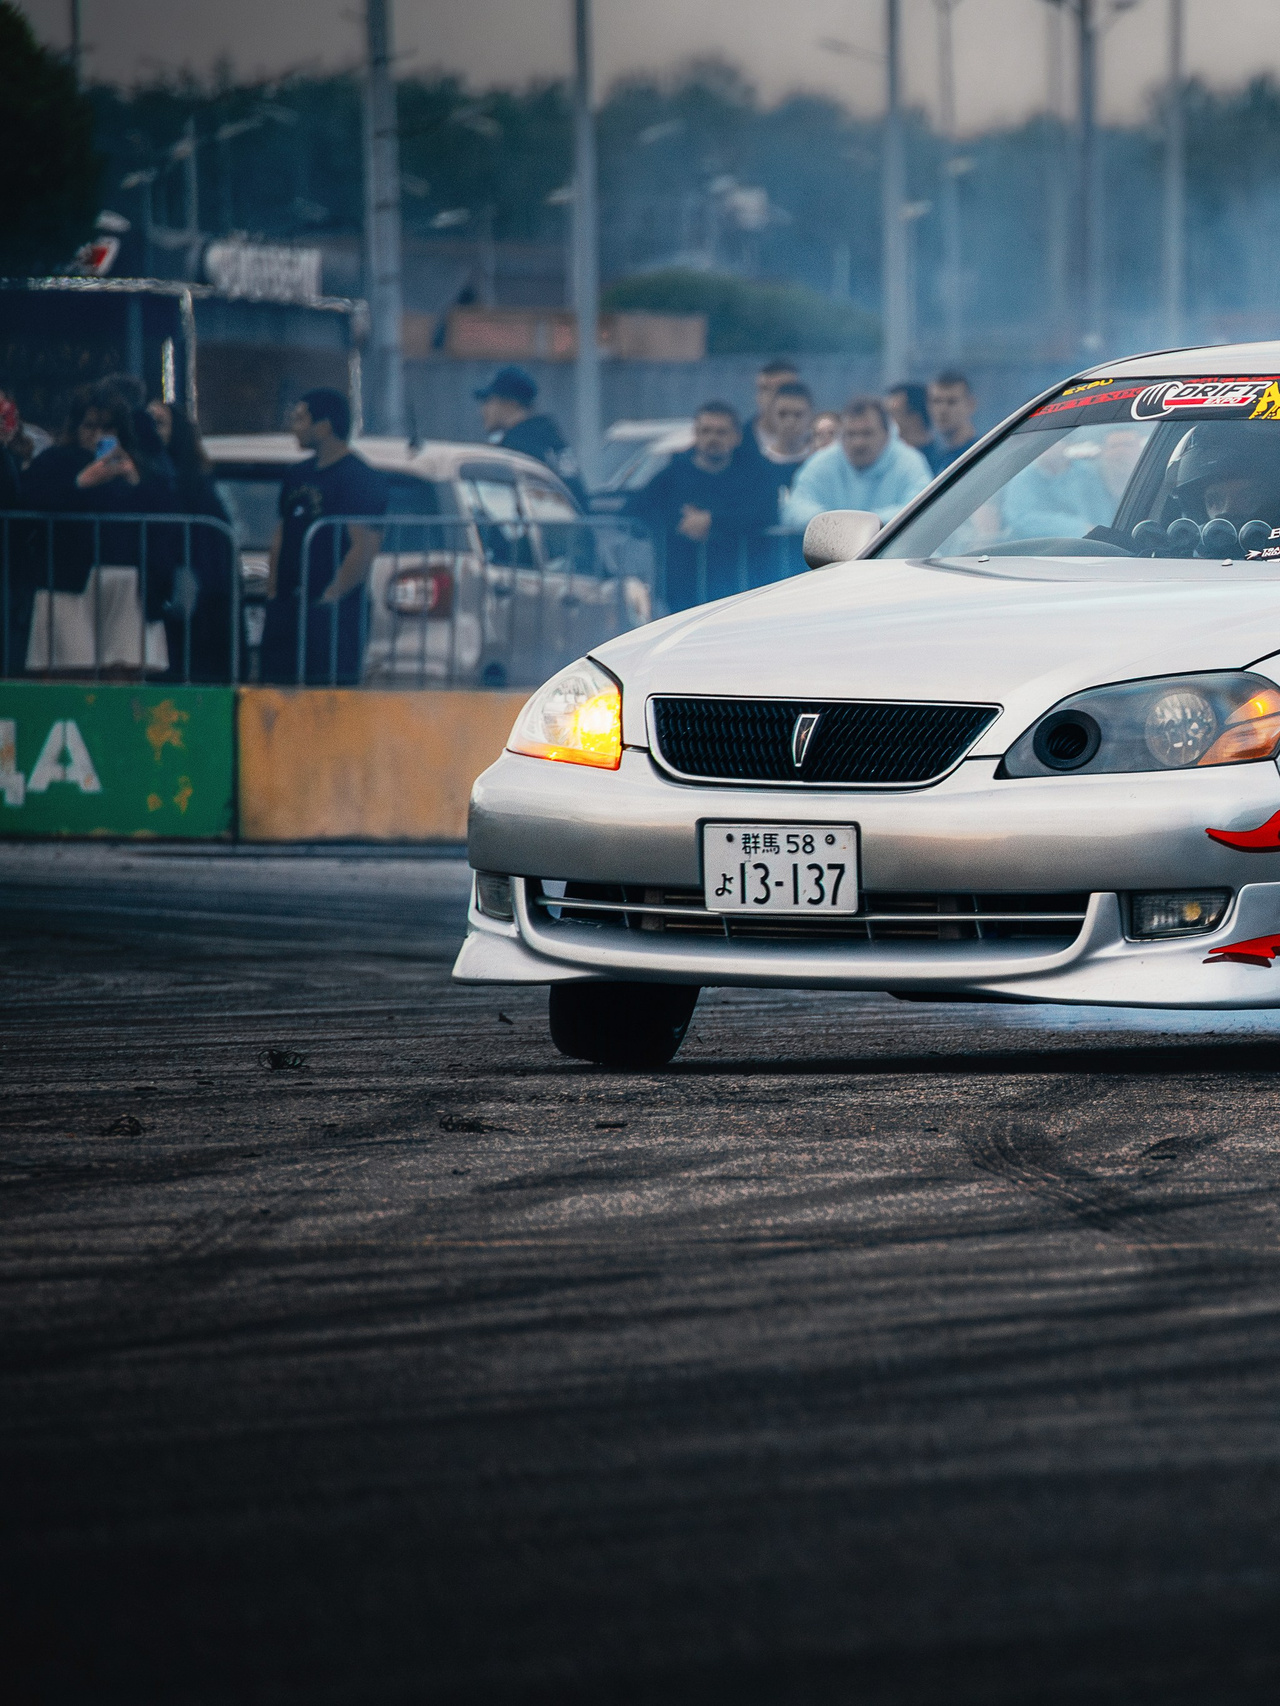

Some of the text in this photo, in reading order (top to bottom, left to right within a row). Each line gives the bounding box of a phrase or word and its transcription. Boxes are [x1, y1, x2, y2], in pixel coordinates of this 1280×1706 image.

[1174, 382, 1269, 398] DRIFT
[1202, 396, 1244, 405] EXPO
[741, 833, 815, 855] 群馬 58
[715, 862, 846, 905] よ 13-137
